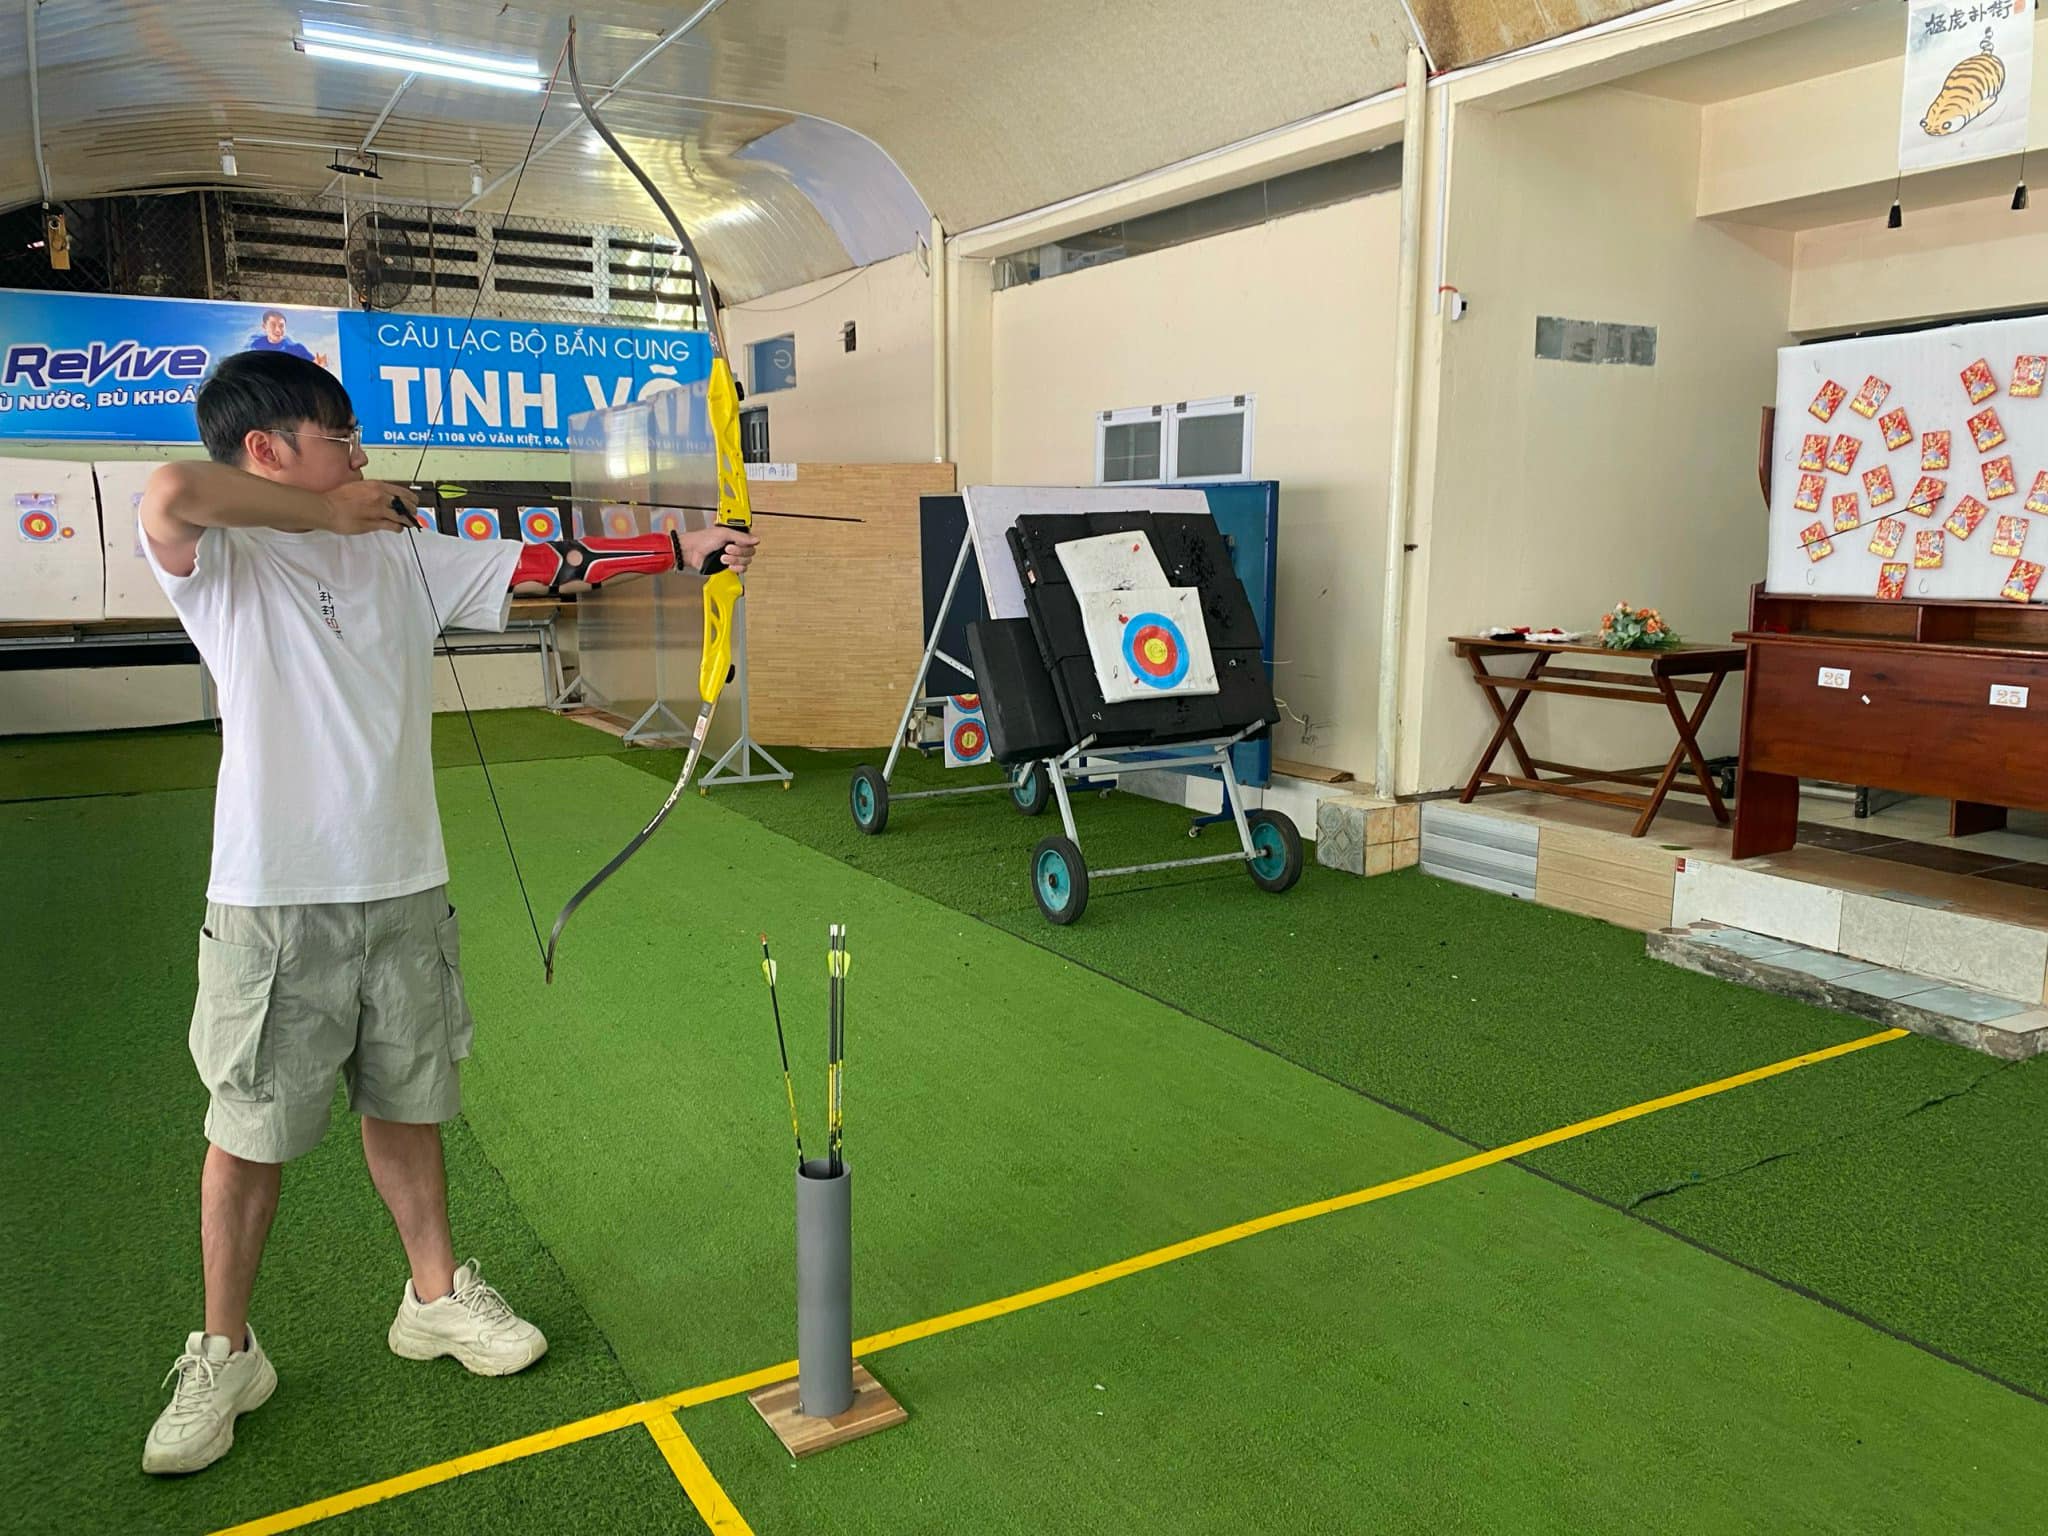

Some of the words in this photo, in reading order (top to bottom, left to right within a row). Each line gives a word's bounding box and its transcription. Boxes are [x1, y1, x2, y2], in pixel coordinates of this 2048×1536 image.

[378, 320, 439, 349] CÂU
[448, 327, 501, 355] LẠC
[510, 328, 547, 358] BỘ
[555, 328, 606, 357] BẮN
[614, 338, 690, 361] CUNG
[3, 340, 209, 389] ReVive
[18, 389, 91, 411] NƯỚC,
[97, 388, 128, 407] BÙ
[380, 365, 559, 429] TINH
[384, 430, 405, 444] ĐỊA
[408, 429, 434, 442] CHỈ:
[438, 432, 466, 443] 1108
[489, 432, 514, 444] VĂN
